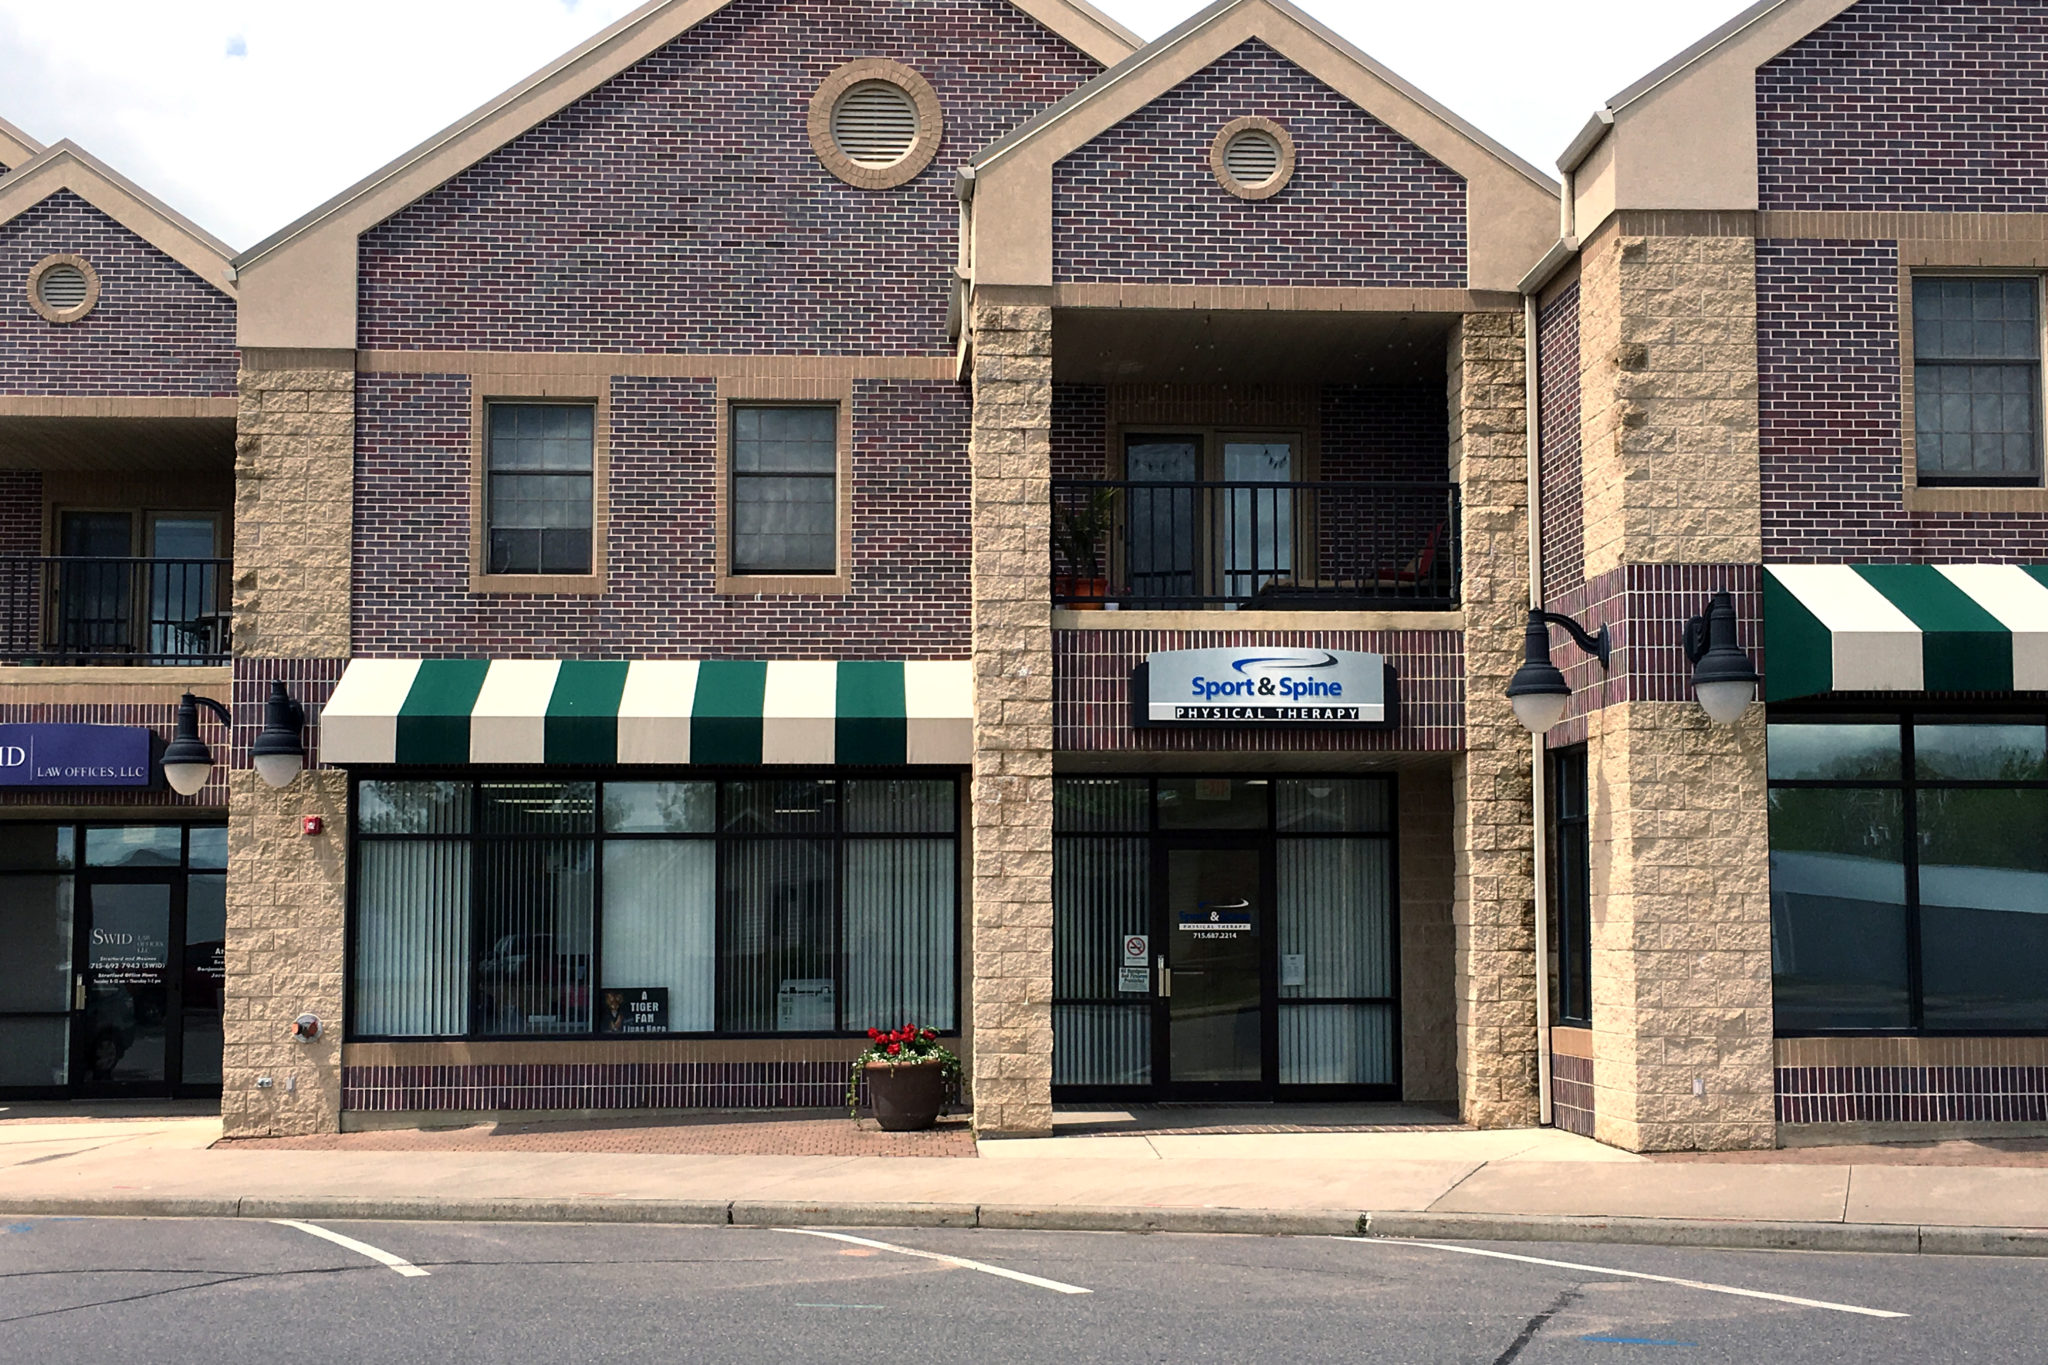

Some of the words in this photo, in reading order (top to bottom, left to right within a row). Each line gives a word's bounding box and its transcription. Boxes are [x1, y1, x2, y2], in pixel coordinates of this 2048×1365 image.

[1191, 676, 1254, 701] Sport
[1257, 676, 1276, 696] &
[1279, 676, 1343, 701] Spine
[1176, 708, 1265, 719] PHYSICAL
[1276, 708, 1359, 719] THERAPY
[37, 766, 62, 778] LAW
[64, 766, 118, 779] OFFICES,
[120, 766, 145, 778] LLC
[1210, 911, 1219, 921] &
[92, 927, 133, 945] SWID
[641, 990, 648, 1001] A
[630, 1001, 659, 1012] TIGER
[635, 1013, 655, 1023] FAN
